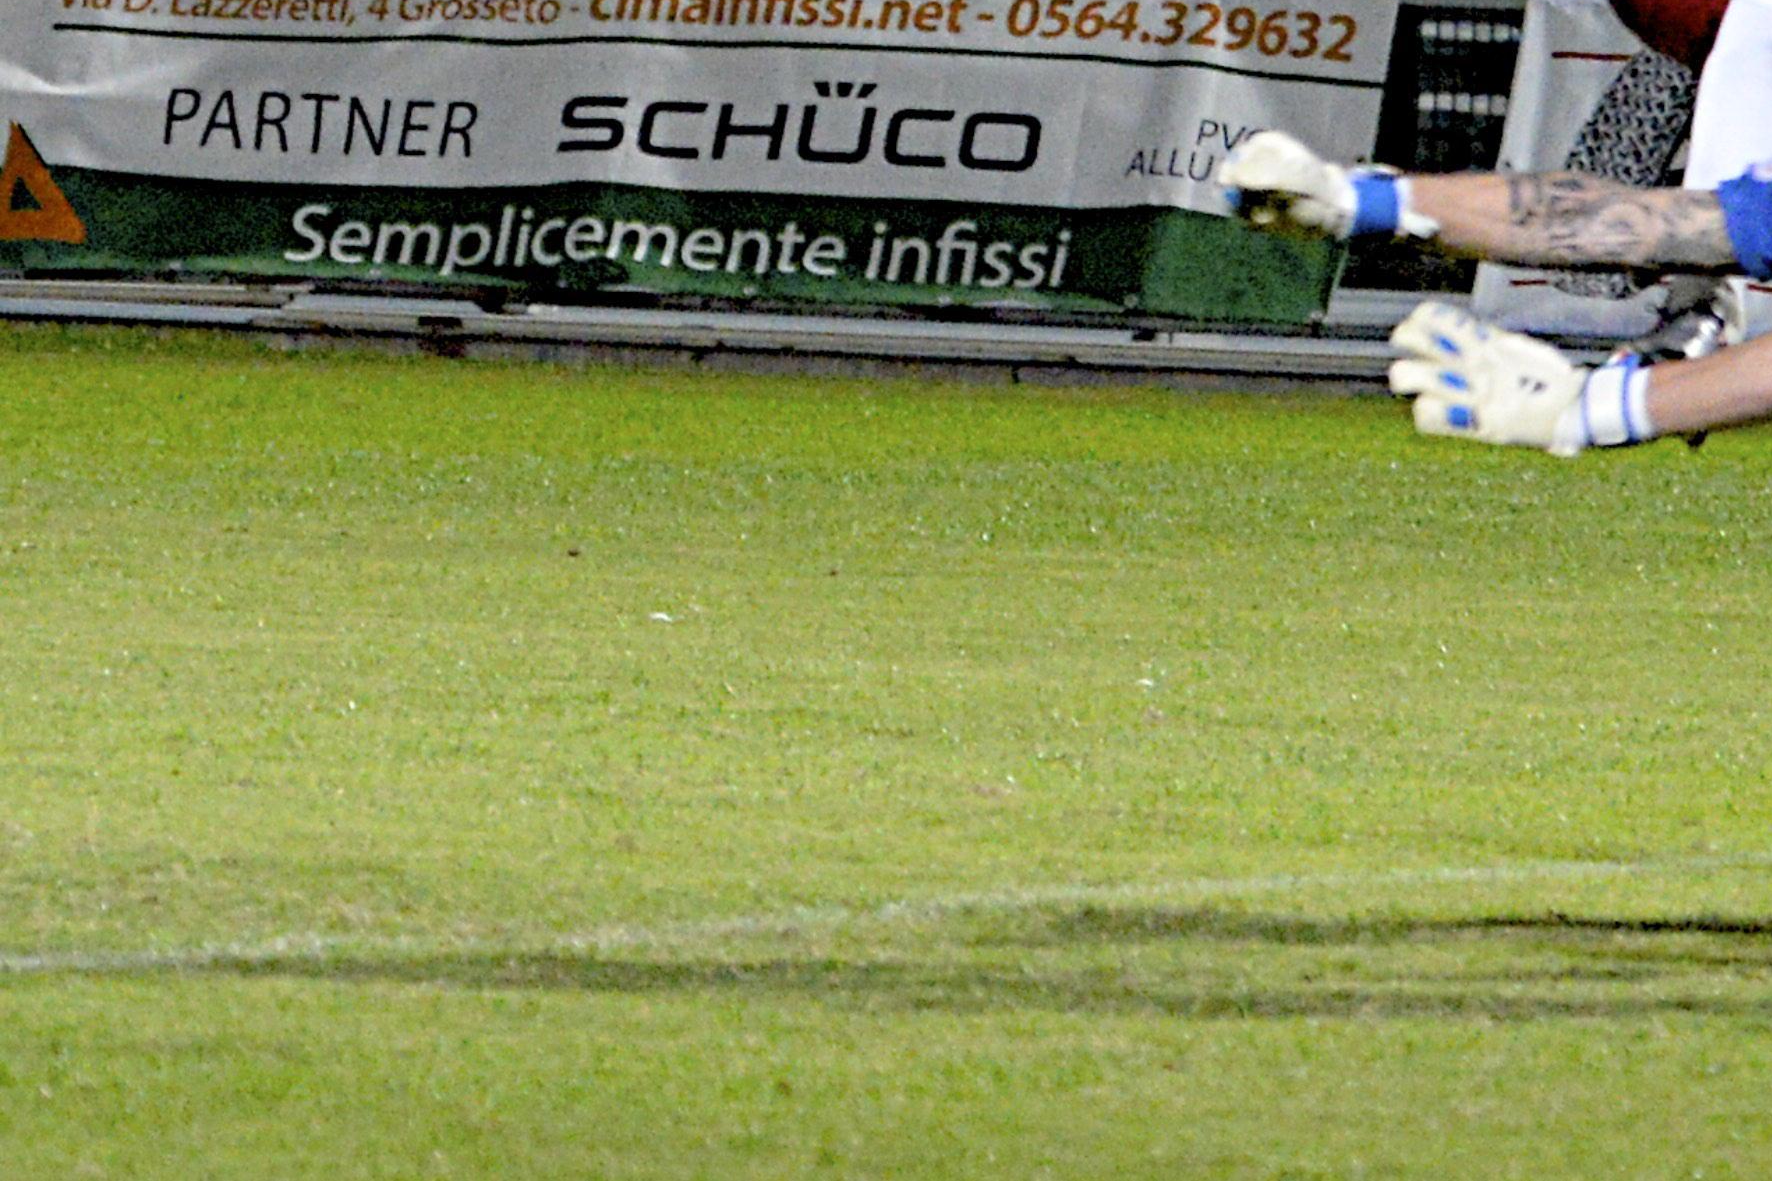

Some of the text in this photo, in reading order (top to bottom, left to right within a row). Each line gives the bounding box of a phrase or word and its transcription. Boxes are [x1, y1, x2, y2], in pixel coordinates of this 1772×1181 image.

[162, 80, 1042, 172] PARTNER SCHÜCO
[1197, 119, 1266, 151] PV
[284, 204, 1071, 288] Semplicemente infissi
